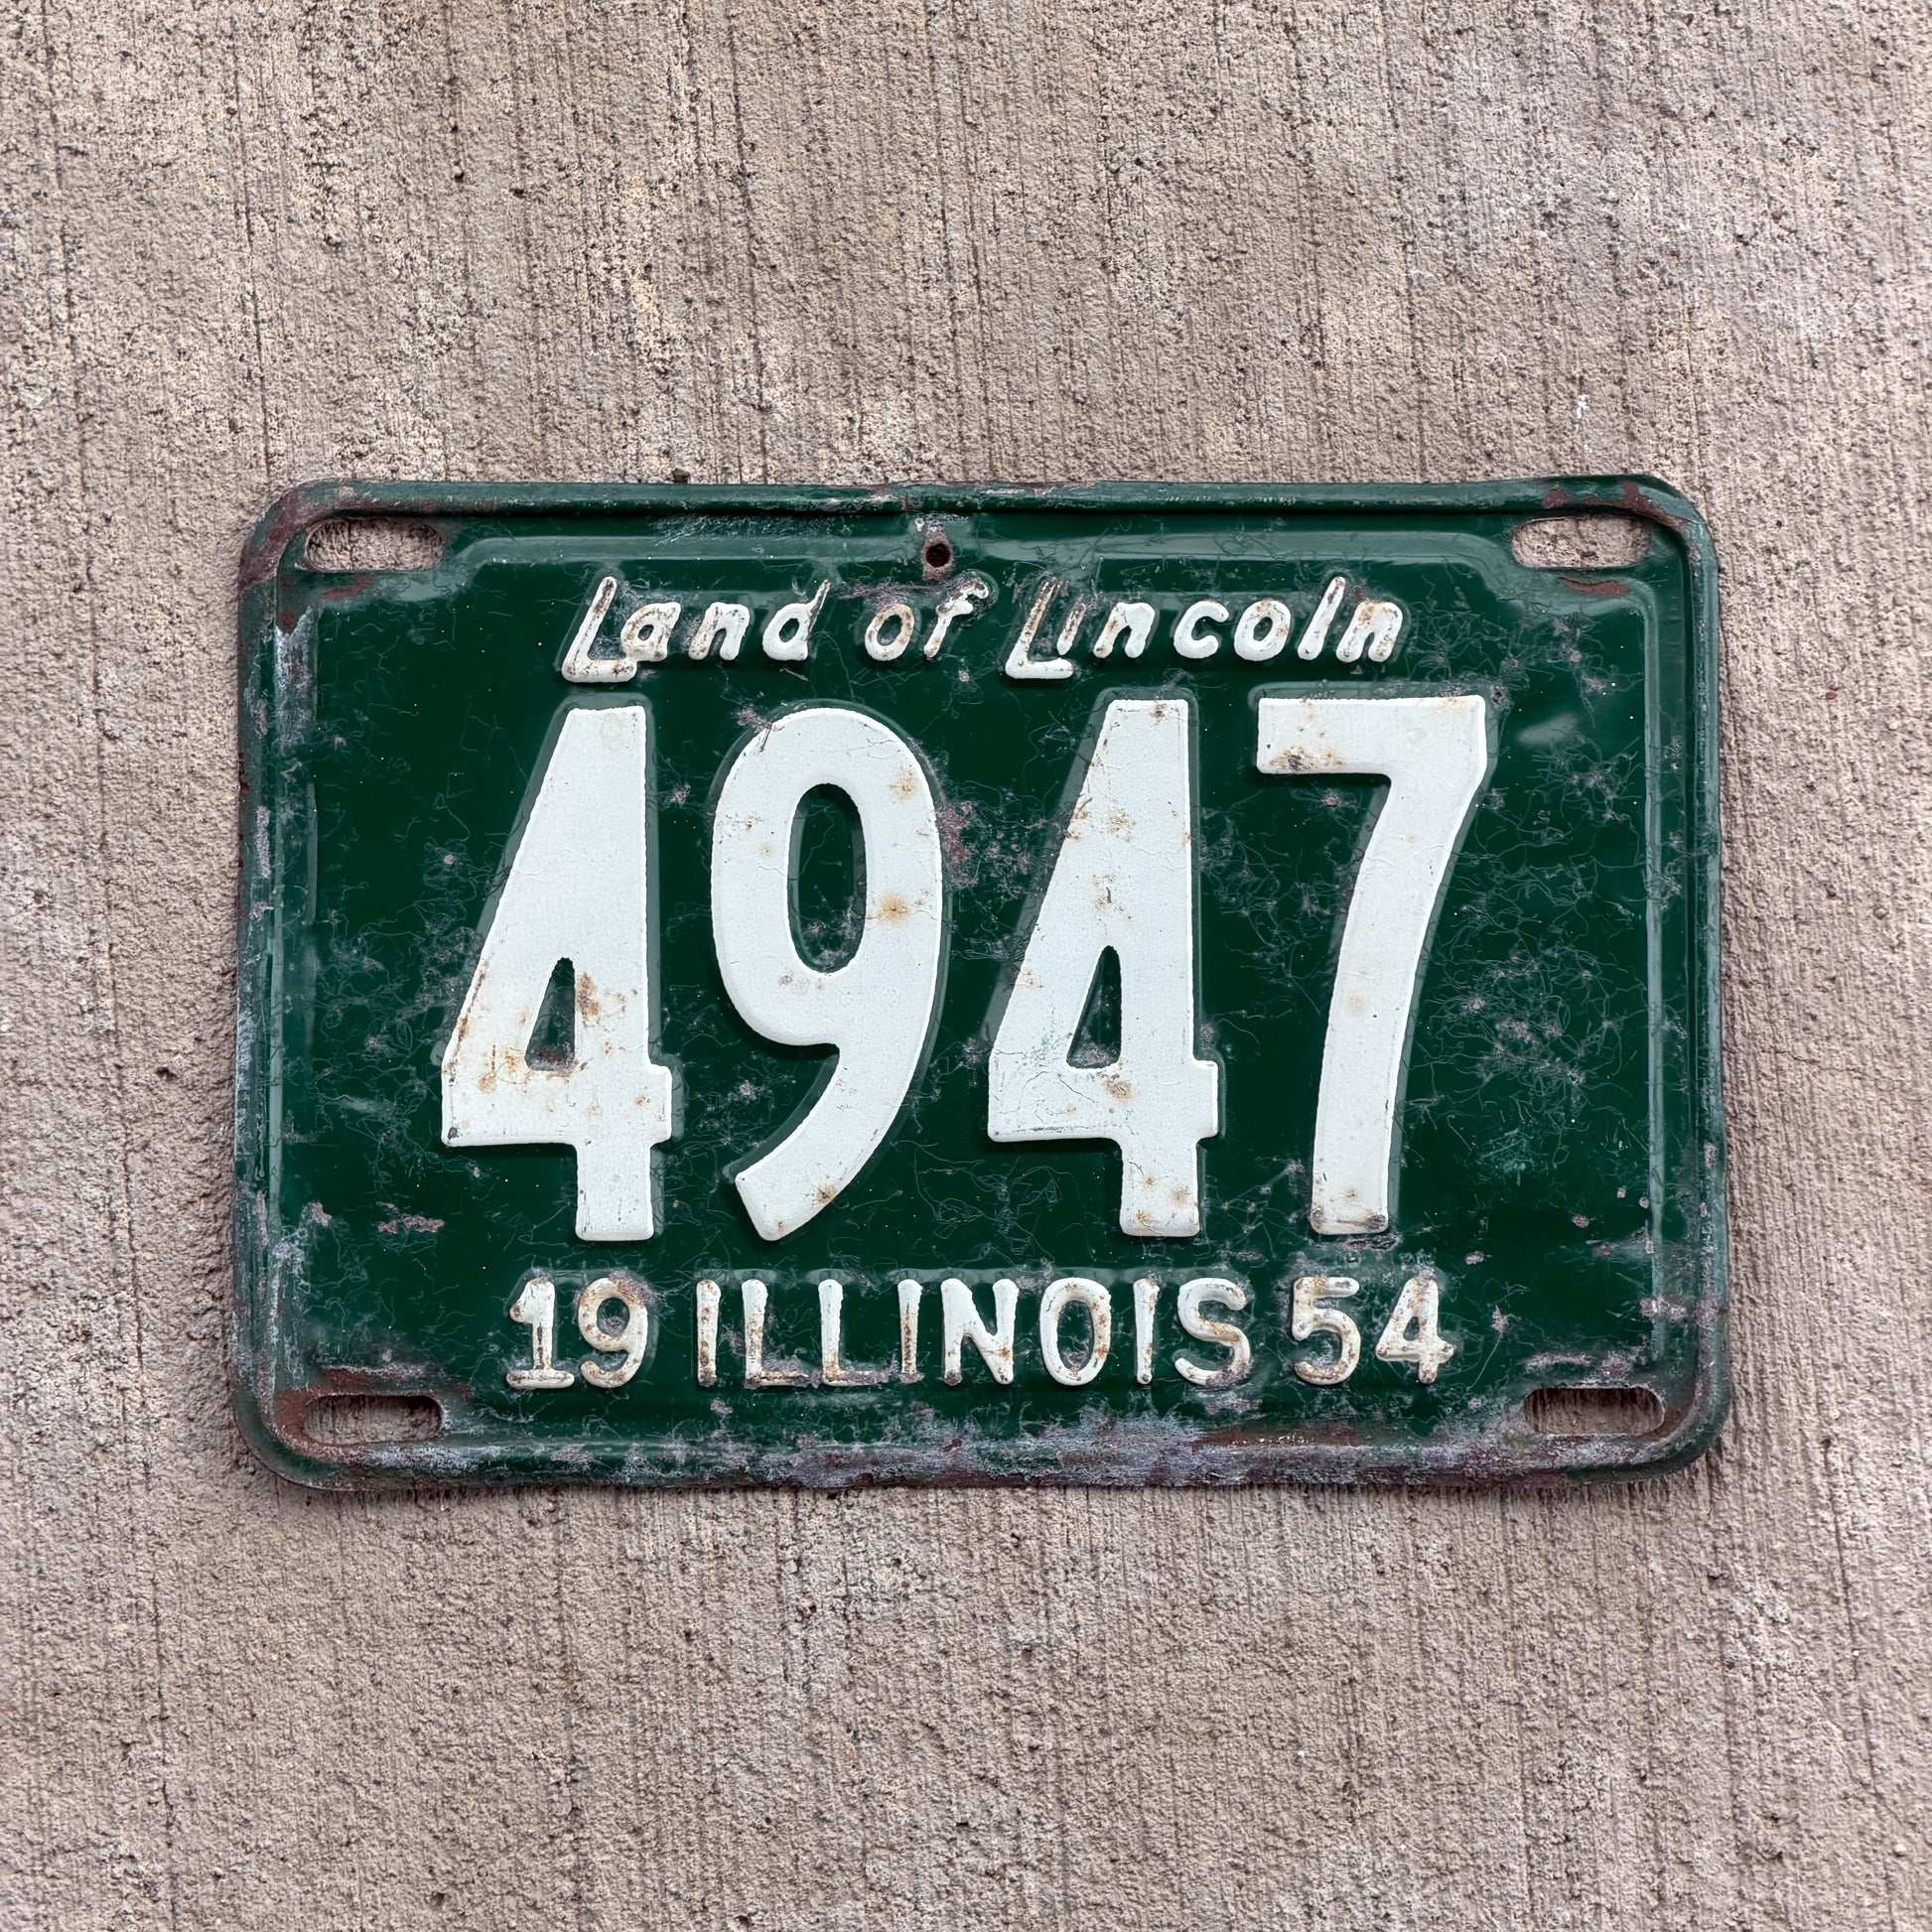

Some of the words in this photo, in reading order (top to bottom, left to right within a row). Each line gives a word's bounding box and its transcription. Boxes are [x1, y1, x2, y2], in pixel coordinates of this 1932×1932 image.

[561, 575, 832, 682] Land
[863, 577, 991, 662] of
[1005, 575, 1405, 680] Lincoln
[440, 694, 1488, 1242] 4947
[506, 1274, 650, 1389] 19
[695, 1274, 1254, 1387] ILLINOIS
[1289, 1274, 1457, 1387] 54
